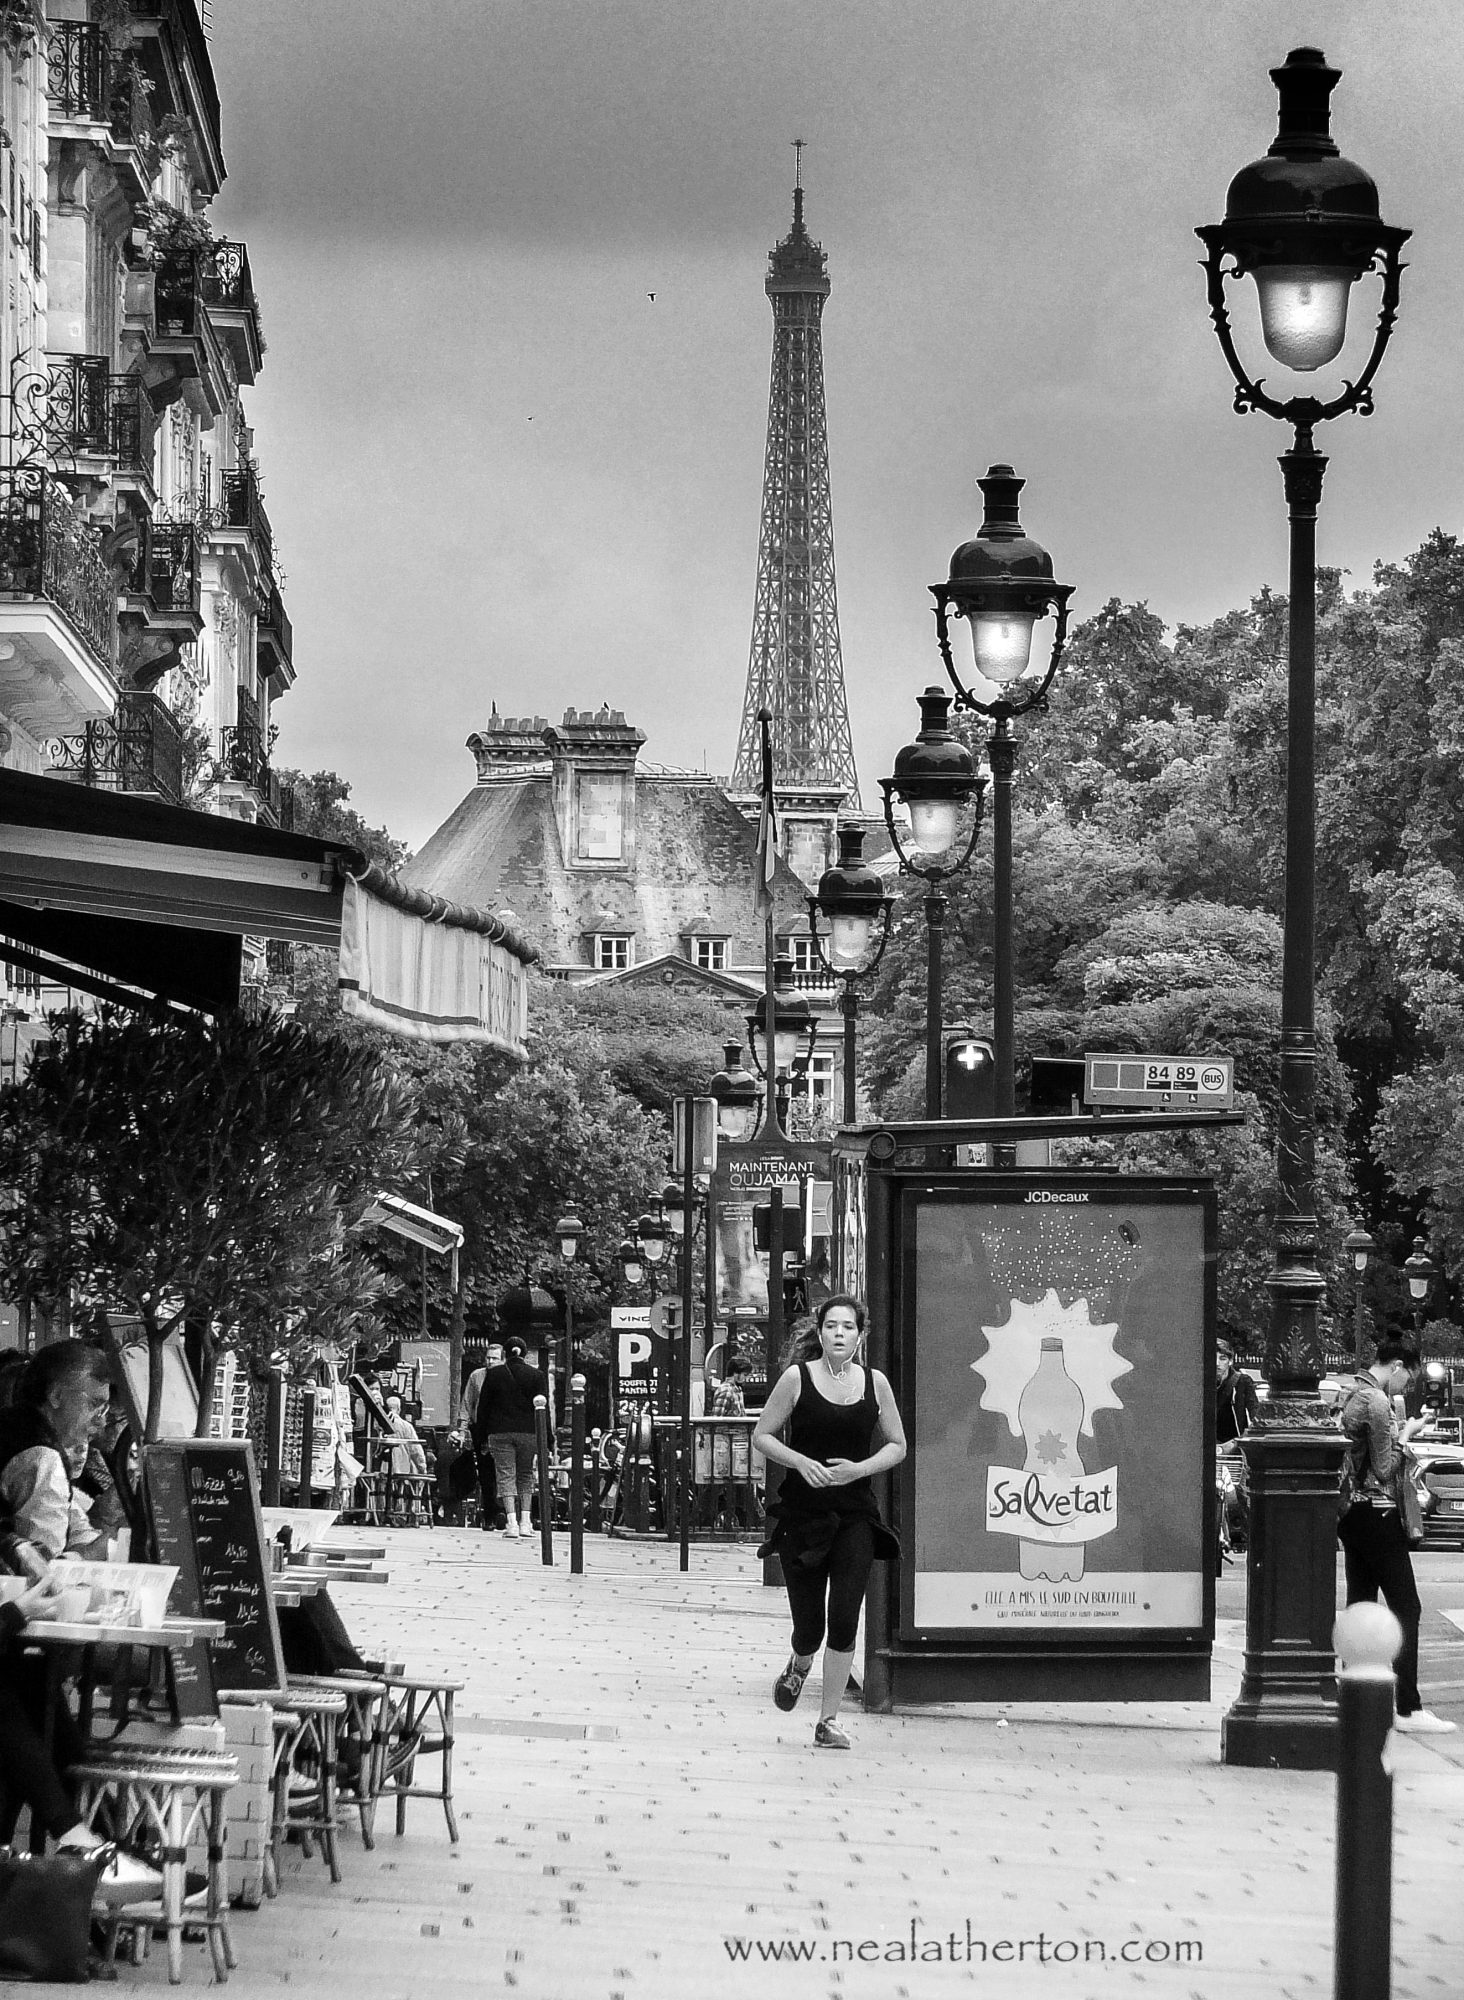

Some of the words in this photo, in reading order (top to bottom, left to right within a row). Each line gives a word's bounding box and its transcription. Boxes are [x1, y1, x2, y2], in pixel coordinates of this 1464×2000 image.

[1148, 1066, 1169, 1079] 84
[1176, 1067, 1195, 1080] 89
[1204, 1074, 1222, 1083] BUS
[729, 1161, 815, 1172] MAINTENANT
[1024, 1191, 1089, 1203] JCDecaux
[618, 1333, 652, 1377] P
[990, 1473, 1112, 1526] Salvetat
[985, 1591, 1004, 1604] ELLE
[1008, 1591, 1016, 1604] A
[1019, 1591, 1036, 1604] MIS
[1039, 1591, 1047, 1604] LE
[1052, 1591, 1071, 1604] SUD
[1074, 1591, 1089, 1604] EN
[1091, 1591, 1137, 1604] BOUTEILLE
